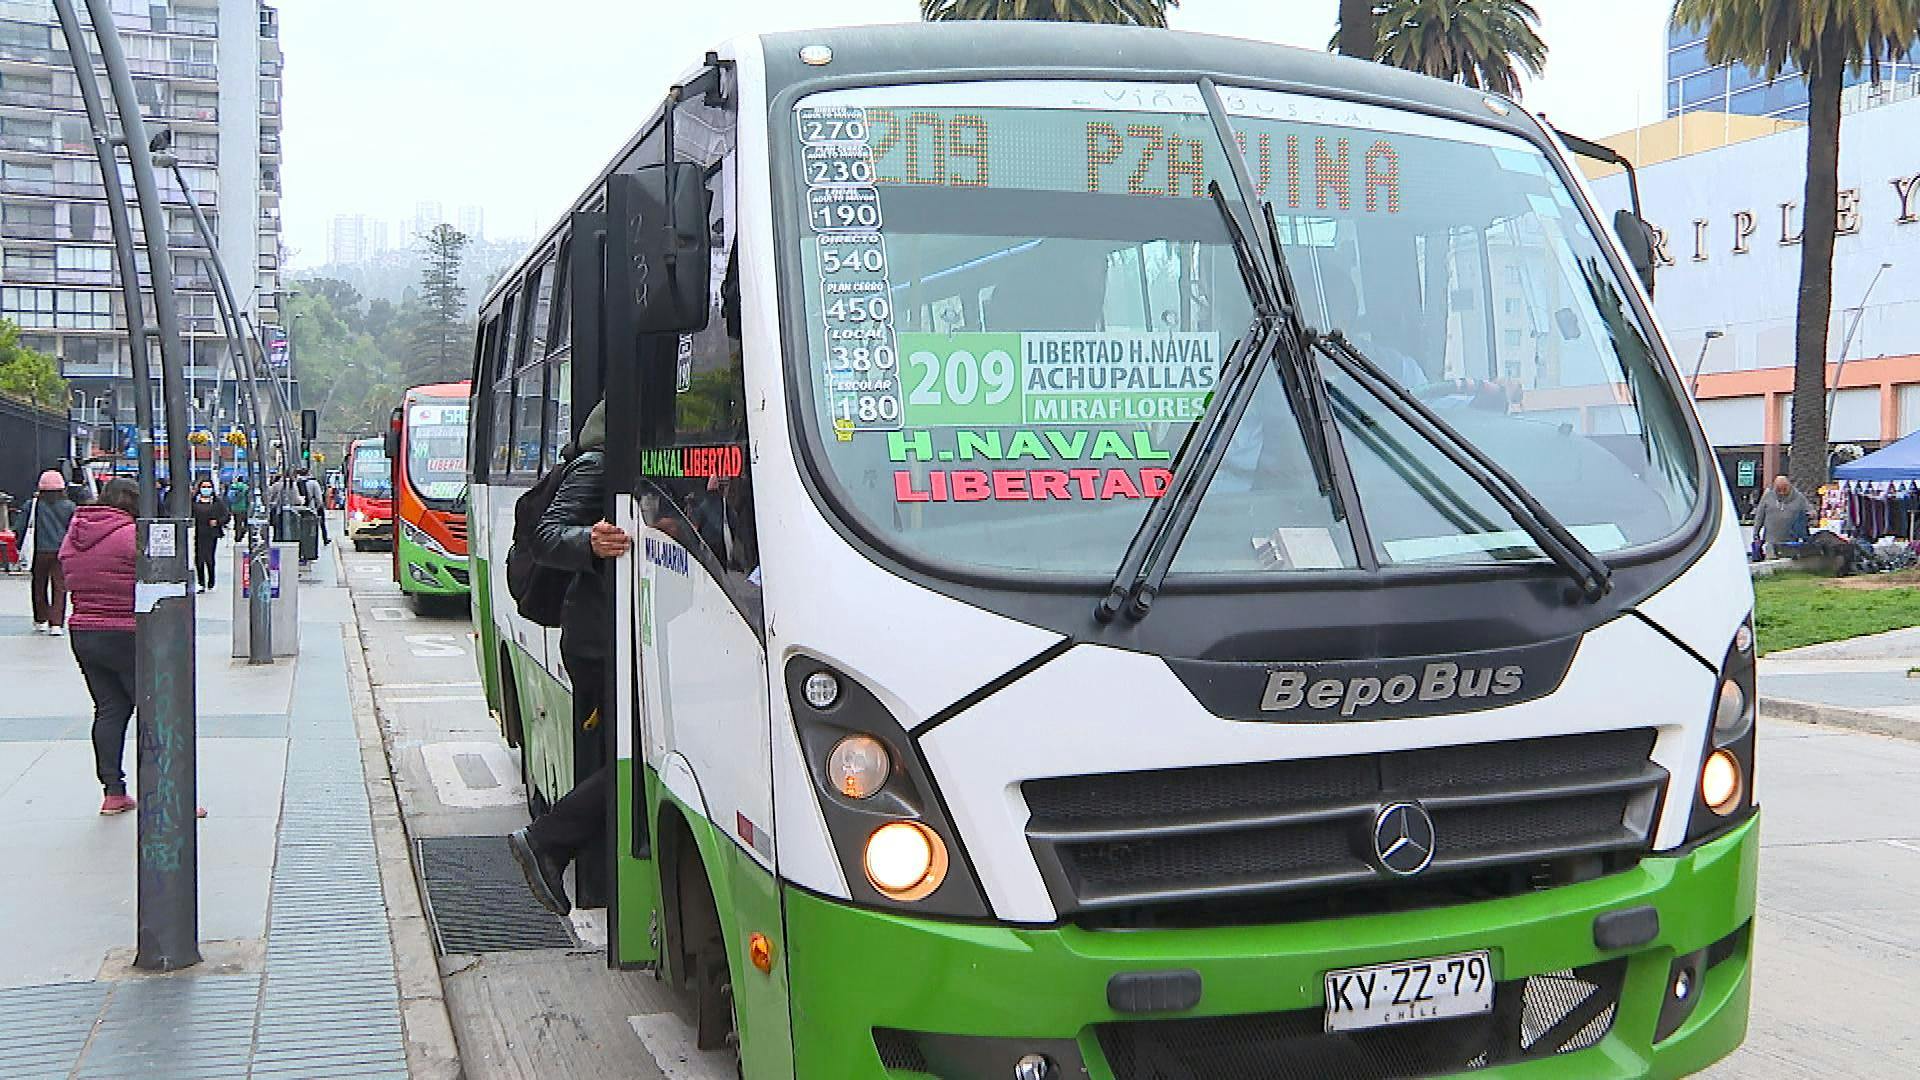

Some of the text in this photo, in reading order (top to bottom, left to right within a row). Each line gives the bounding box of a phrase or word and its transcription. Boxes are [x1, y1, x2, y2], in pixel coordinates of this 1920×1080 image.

[864, 109, 988, 187] 209
[823, 249, 883, 272] 540
[827, 281, 884, 292] PLAN CERRO
[827, 297, 889, 322] 450
[831, 329, 883, 339] LOCAL
[832, 346, 894, 371] 380
[908, 338, 1214, 405] 209 LIBERTAD H.NAVAL
[1027, 365, 1214, 391] ACHUPALLAS
[836, 379, 892, 391] ESCOLAR
[840, 395, 898, 421] 180
[1033, 396, 1205, 420] MIRAFLORES
[887, 430, 1170, 461] H.NAVAL
[641, 446, 742, 477] H.NAVAL LIBERTAD
[893, 466, 1174, 503] LIBERTAD
[1260, 662, 1524, 716] BepoBus
[1384, 1006, 1437, 1023] CHILE
